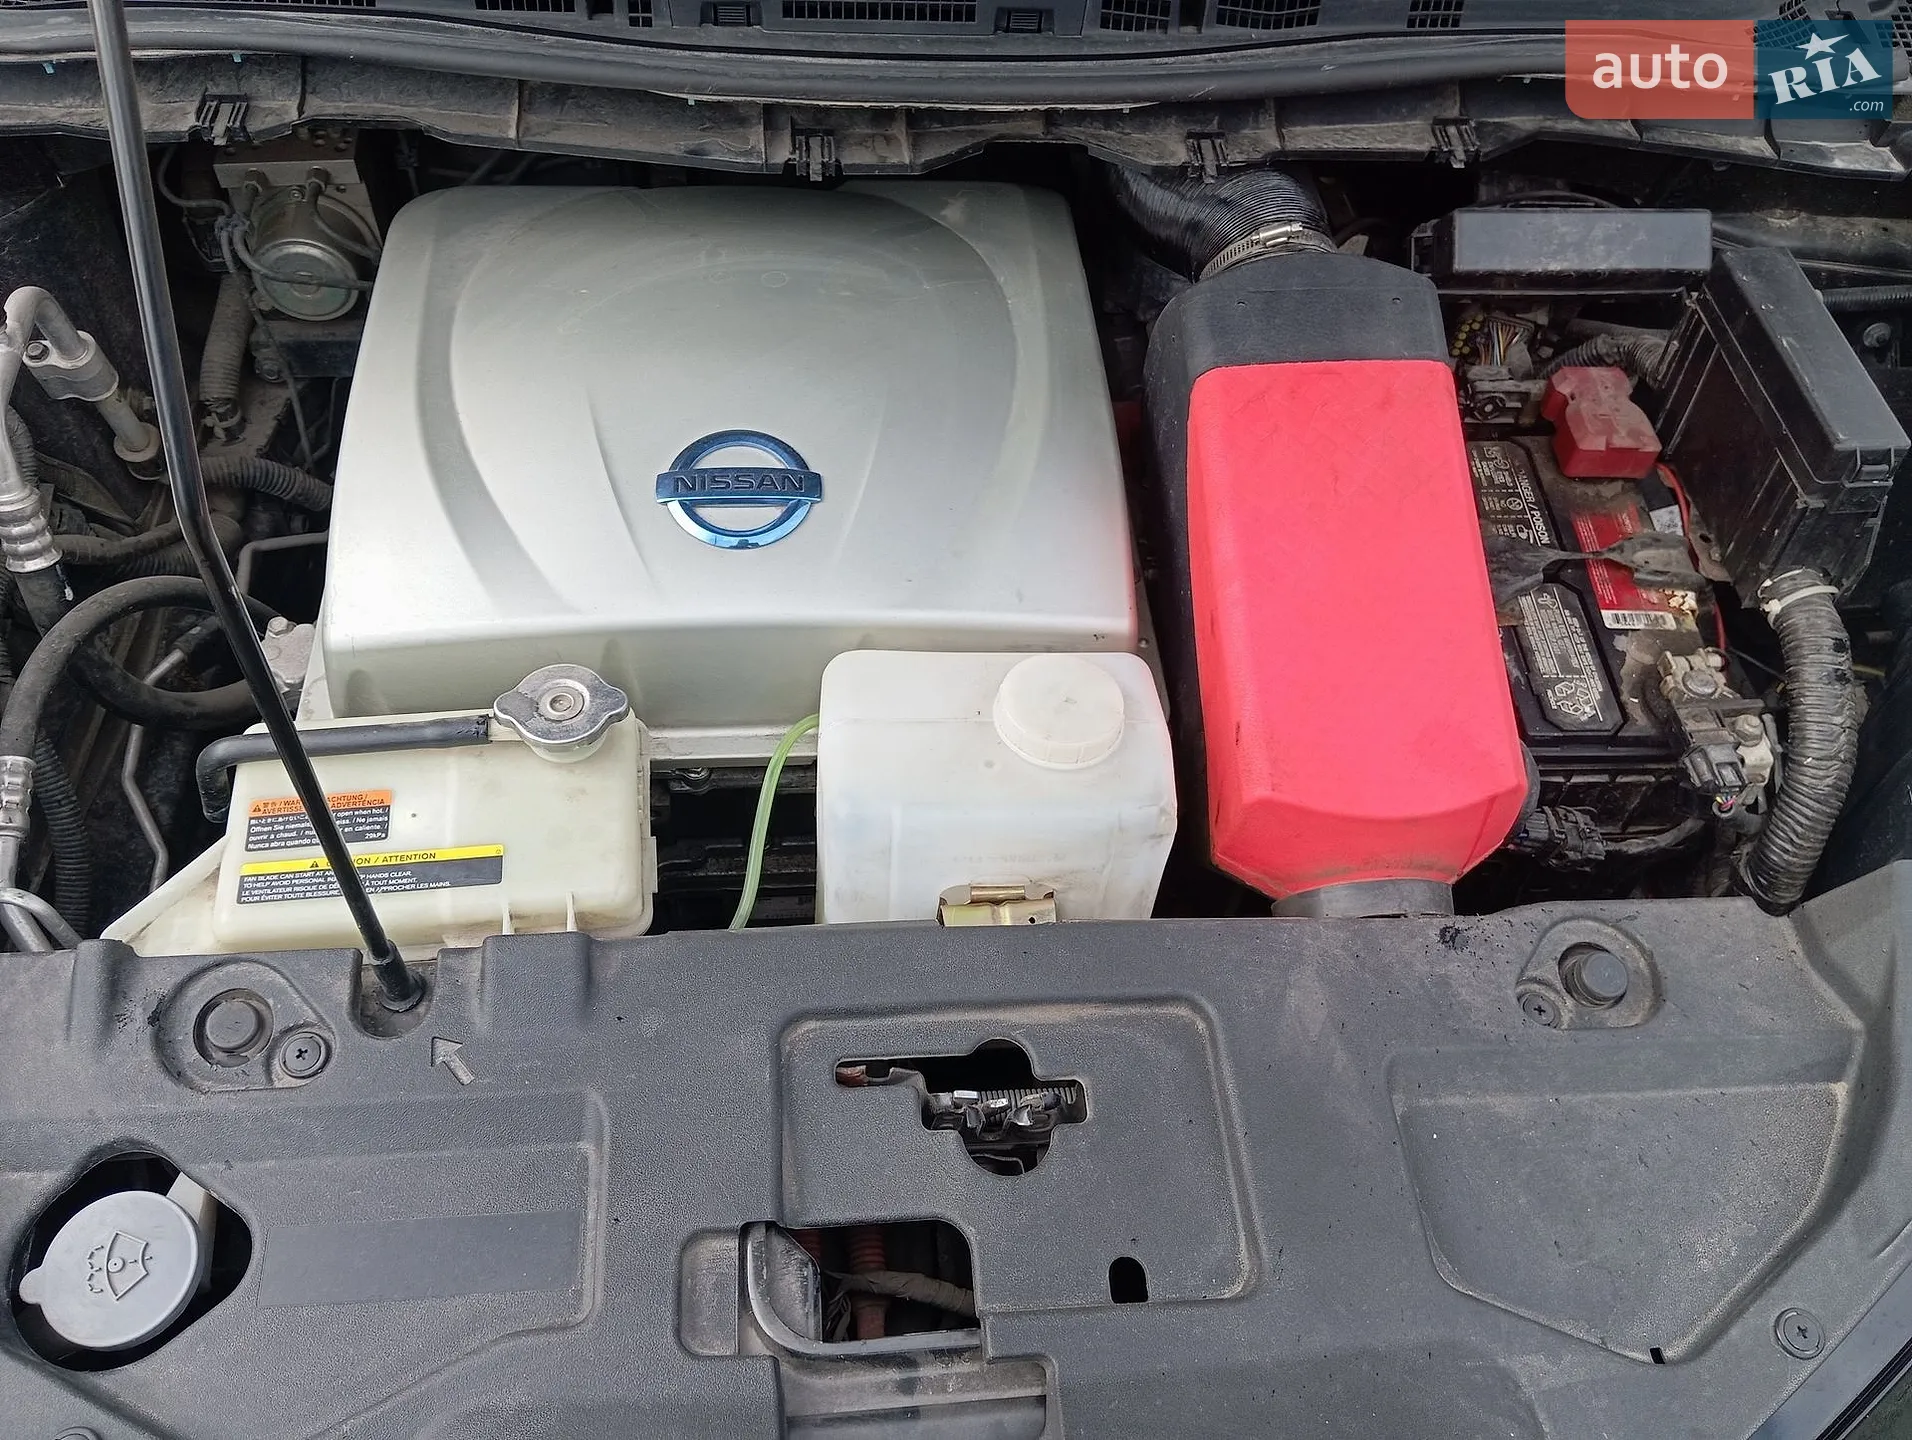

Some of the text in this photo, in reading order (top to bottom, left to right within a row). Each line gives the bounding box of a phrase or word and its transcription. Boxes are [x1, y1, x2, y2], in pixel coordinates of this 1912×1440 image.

[673, 473, 805, 493] NISSAN
[1518, 469, 1536, 503] ANGER
[1531, 510, 1550, 544] POISON
[286, 838, 311, 846] quando
[381, 852, 436, 864] ATTENTION
